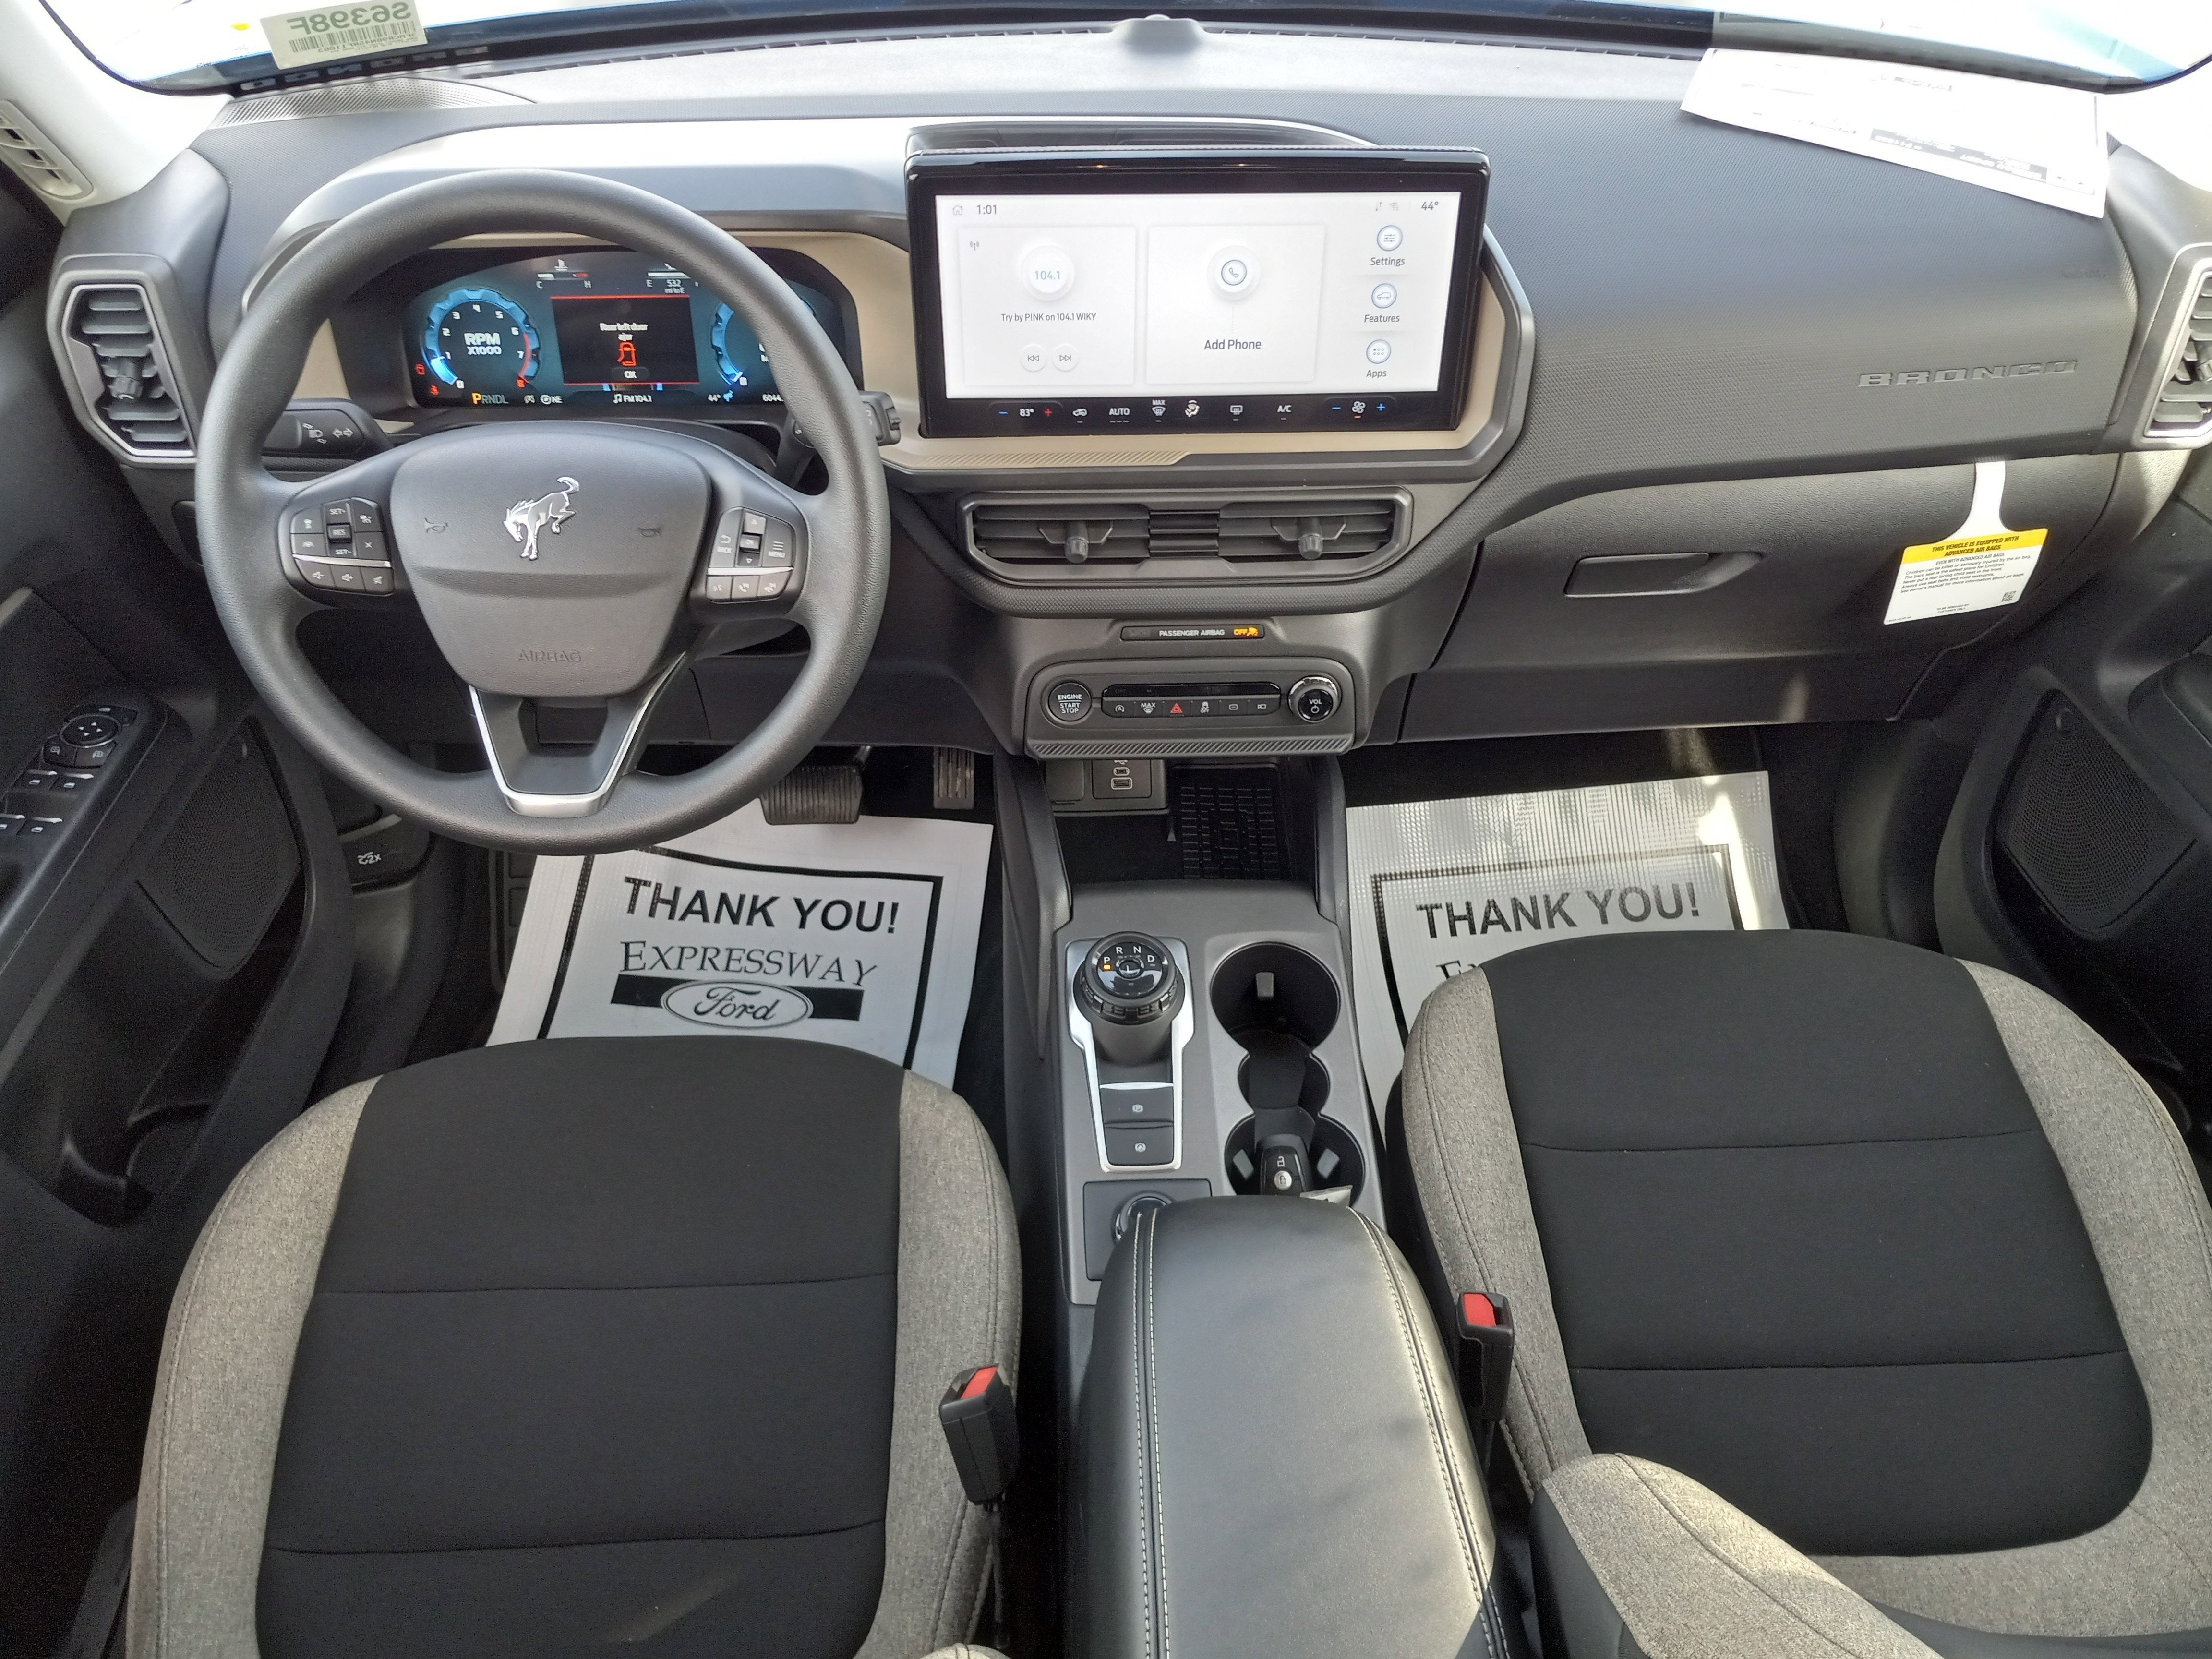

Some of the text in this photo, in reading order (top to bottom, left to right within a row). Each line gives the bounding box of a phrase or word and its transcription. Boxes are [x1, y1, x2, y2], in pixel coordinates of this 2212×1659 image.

[977, 204, 998, 215] 1:01
[1421, 201, 1439, 210] 44°
[1370, 257, 1405, 267] Settings
[1034, 271, 1060, 280] 104.1
[1001, 313, 1013, 322] Try
[1014, 313, 1023, 322] by
[1025, 313, 1044, 321] P!NK
[1364, 314, 1400, 323] Features
[464, 333, 501, 346] RPM
[1204, 339, 1262, 349] Add Phone
[1366, 369, 1387, 378] Apps
[1858, 360, 2078, 387] BRONCO
[1109, 408, 1130, 416] AUTO
[1277, 405, 1292, 413] A/C
[1976, 538, 2003, 546] EQUIPPED
[1944, 548, 1973, 556] ADVANCED
[518, 649, 582, 663] AIRBAG
[625, 876, 900, 934] THANK YOU!
[1416, 882, 1699, 938] THANK YOU!
[694, 987, 781, 1021] Ford
